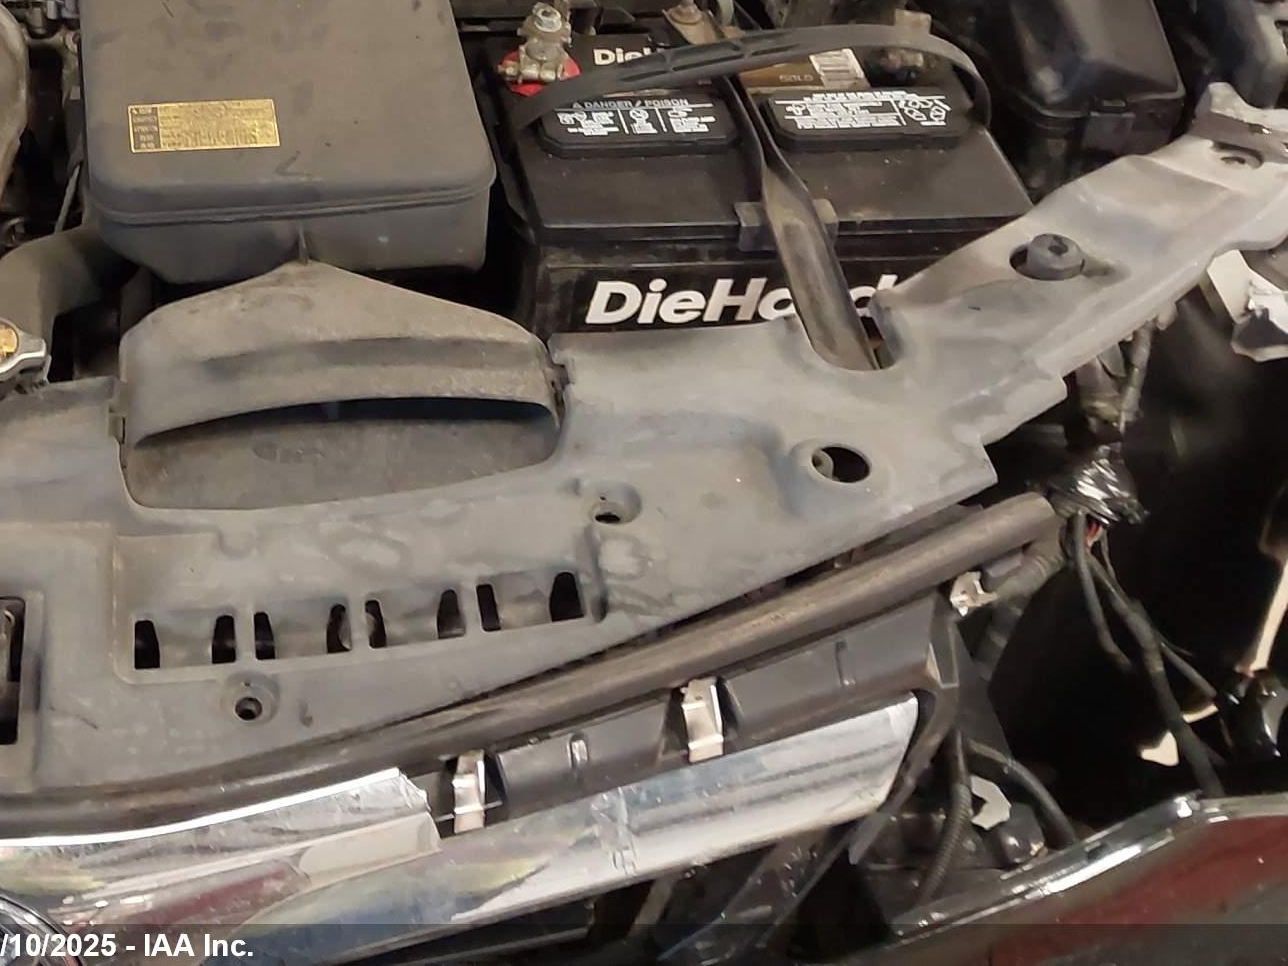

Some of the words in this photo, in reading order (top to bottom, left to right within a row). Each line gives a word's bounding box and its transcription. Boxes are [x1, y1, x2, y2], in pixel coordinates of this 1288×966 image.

[584, 100, 633, 110] DANGER
[644, 98, 690, 108] POISON
[585, 274, 899, 325] DieHad
